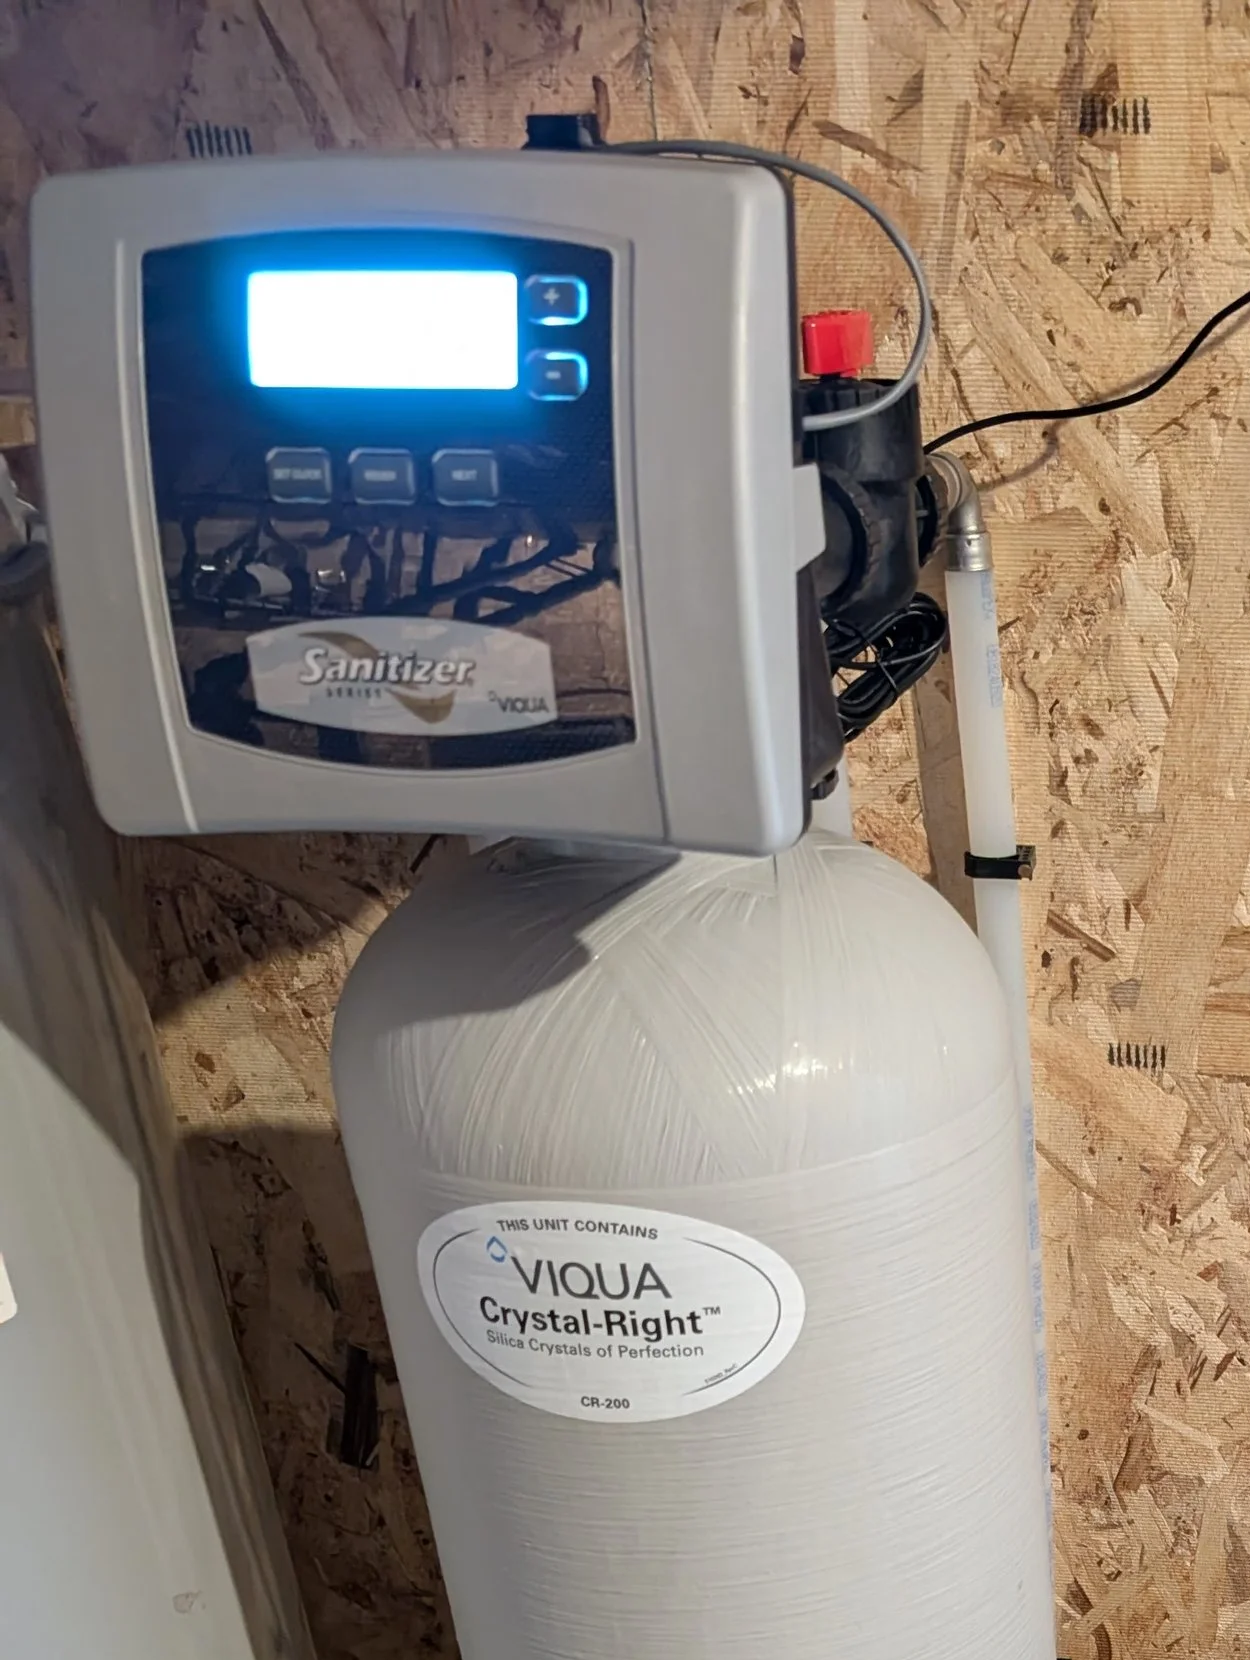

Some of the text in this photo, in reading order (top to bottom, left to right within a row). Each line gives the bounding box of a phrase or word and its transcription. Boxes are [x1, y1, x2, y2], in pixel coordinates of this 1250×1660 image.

[300, 648, 475, 686] Sanitizer
[500, 697, 549, 713] VIQUA
[497, 1218, 659, 1240] THIS UNIT CONTAINS
[511, 1256, 672, 1300] VIQUA
[486, 1329, 704, 1359] Silica Crystals of Perfection
[580, 1396, 631, 1410] CR-200
